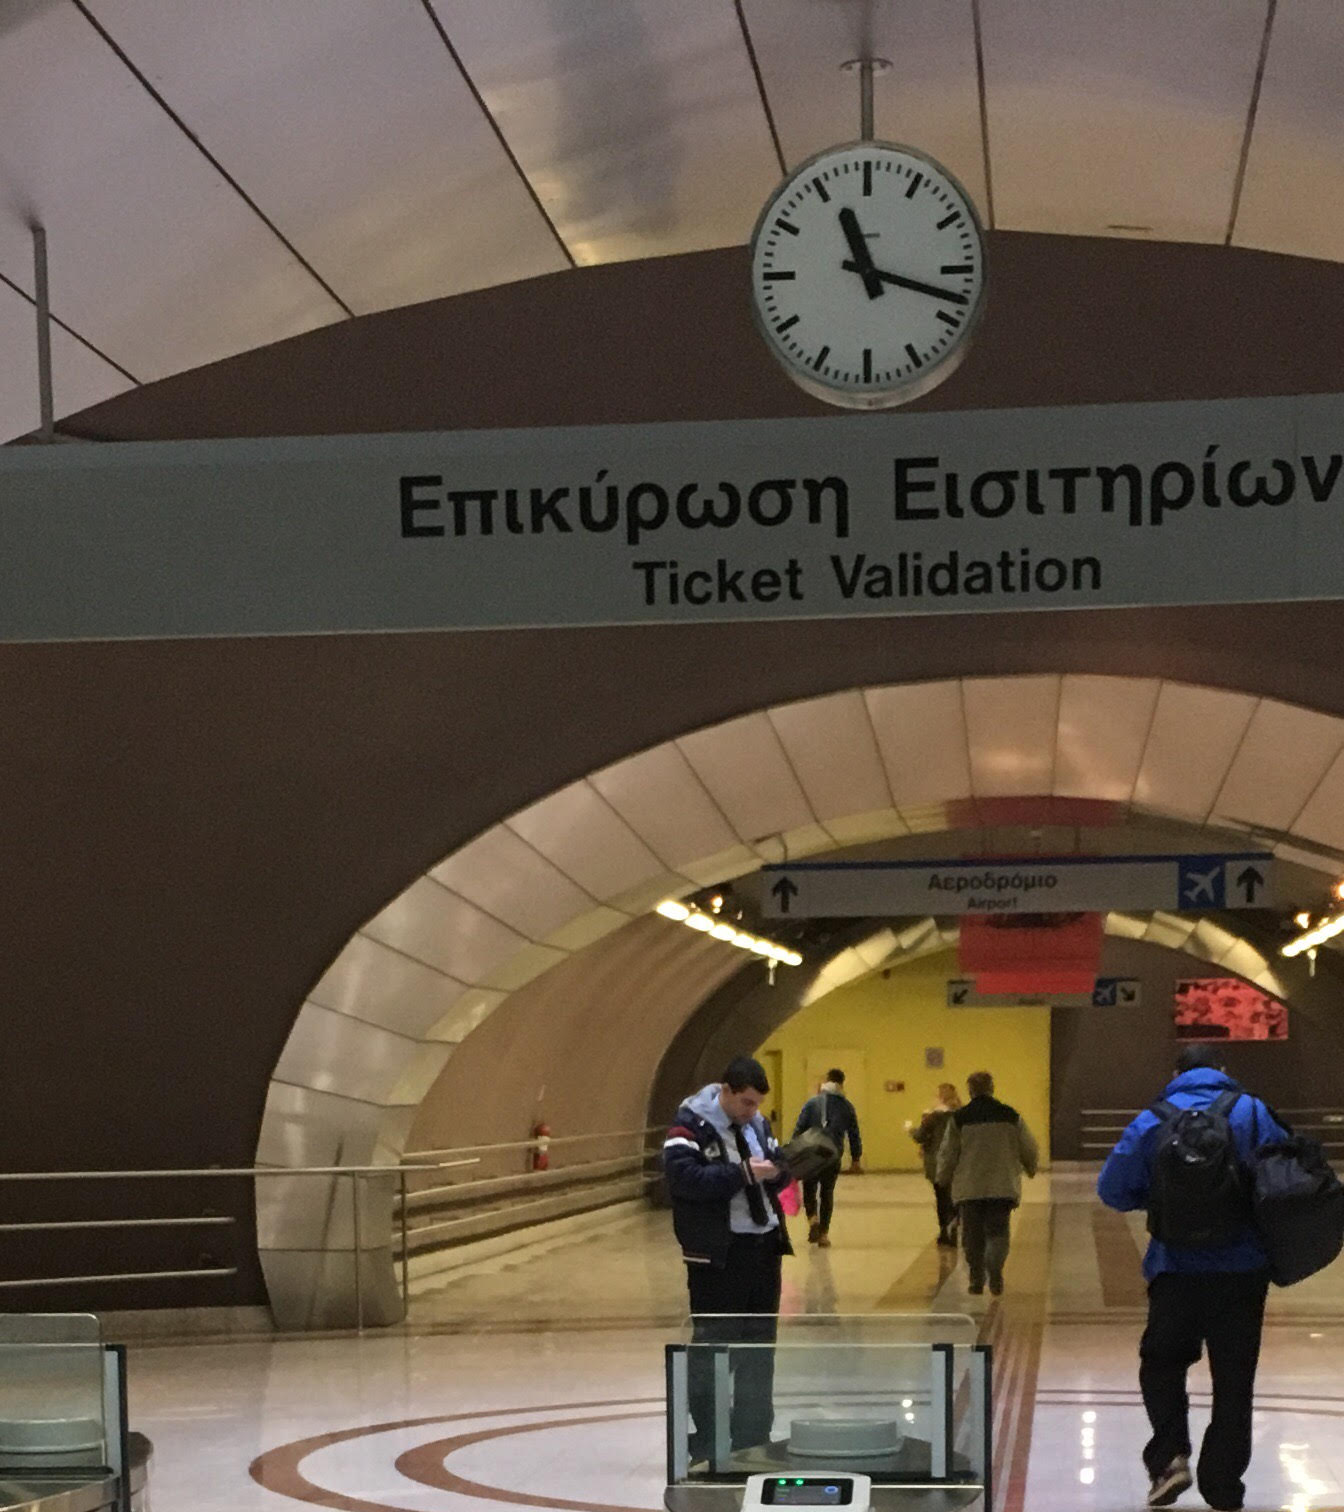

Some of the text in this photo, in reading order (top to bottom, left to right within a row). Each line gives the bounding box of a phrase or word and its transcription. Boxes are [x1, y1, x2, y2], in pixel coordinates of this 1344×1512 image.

[400, 445, 1343, 546] Επικύρωση Εισιτηρίων
[632, 548, 1102, 606] Ticket Validation
[928, 872, 1059, 893] Αεροδρόμιο
[967, 897, 1018, 911] Airport
